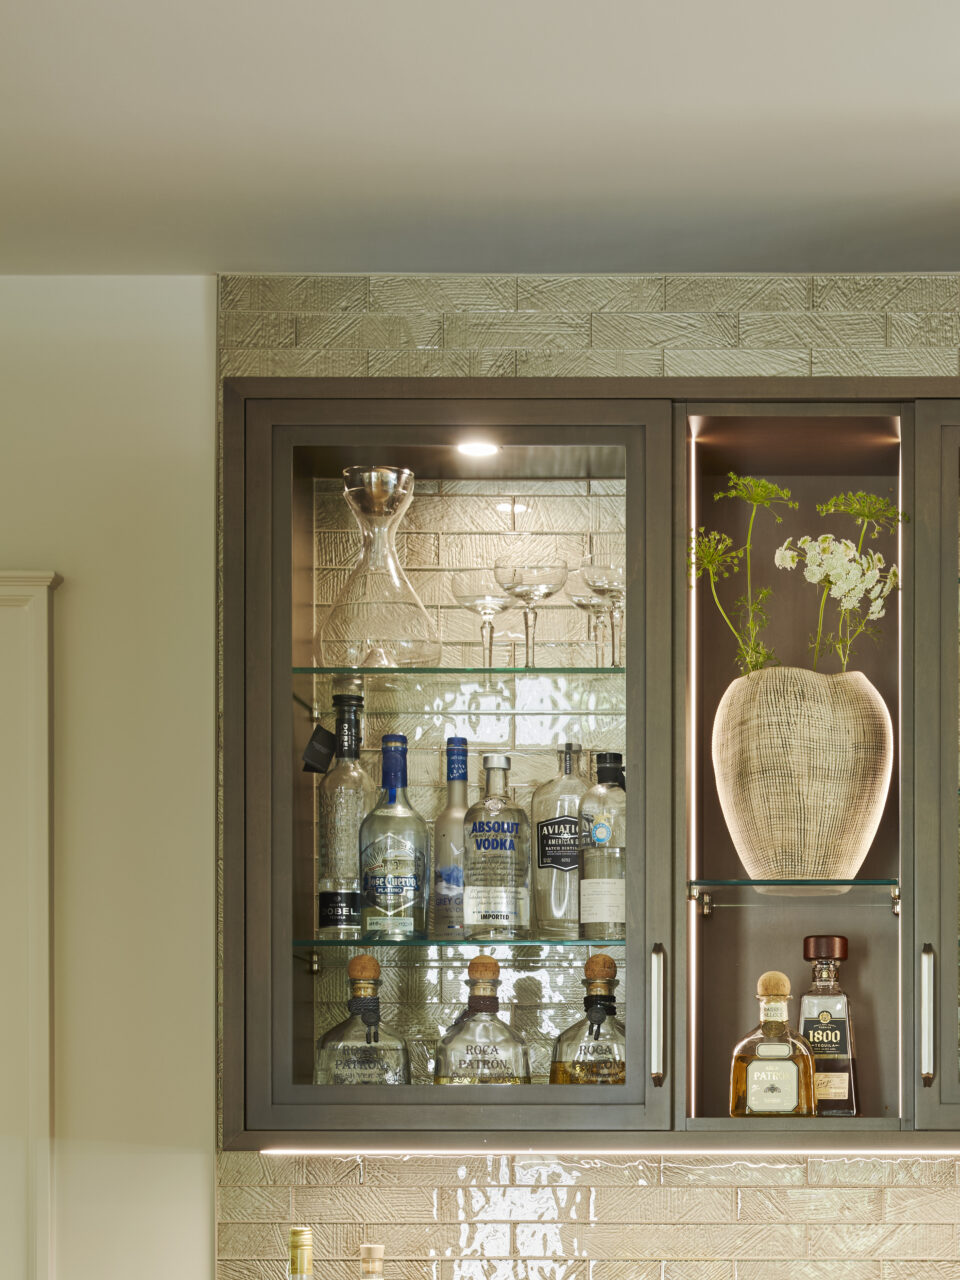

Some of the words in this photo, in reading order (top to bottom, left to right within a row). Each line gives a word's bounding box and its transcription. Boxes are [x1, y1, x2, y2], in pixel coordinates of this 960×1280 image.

[471, 821, 521, 835] ABSOLUT
[475, 838, 516, 852] VODKA
[480, 913, 511, 921] IMPORTED
[808, 1030, 841, 1043] 1800
[465, 1045, 500, 1056] ROCA
[579, 1045, 613, 1056] ROCA
